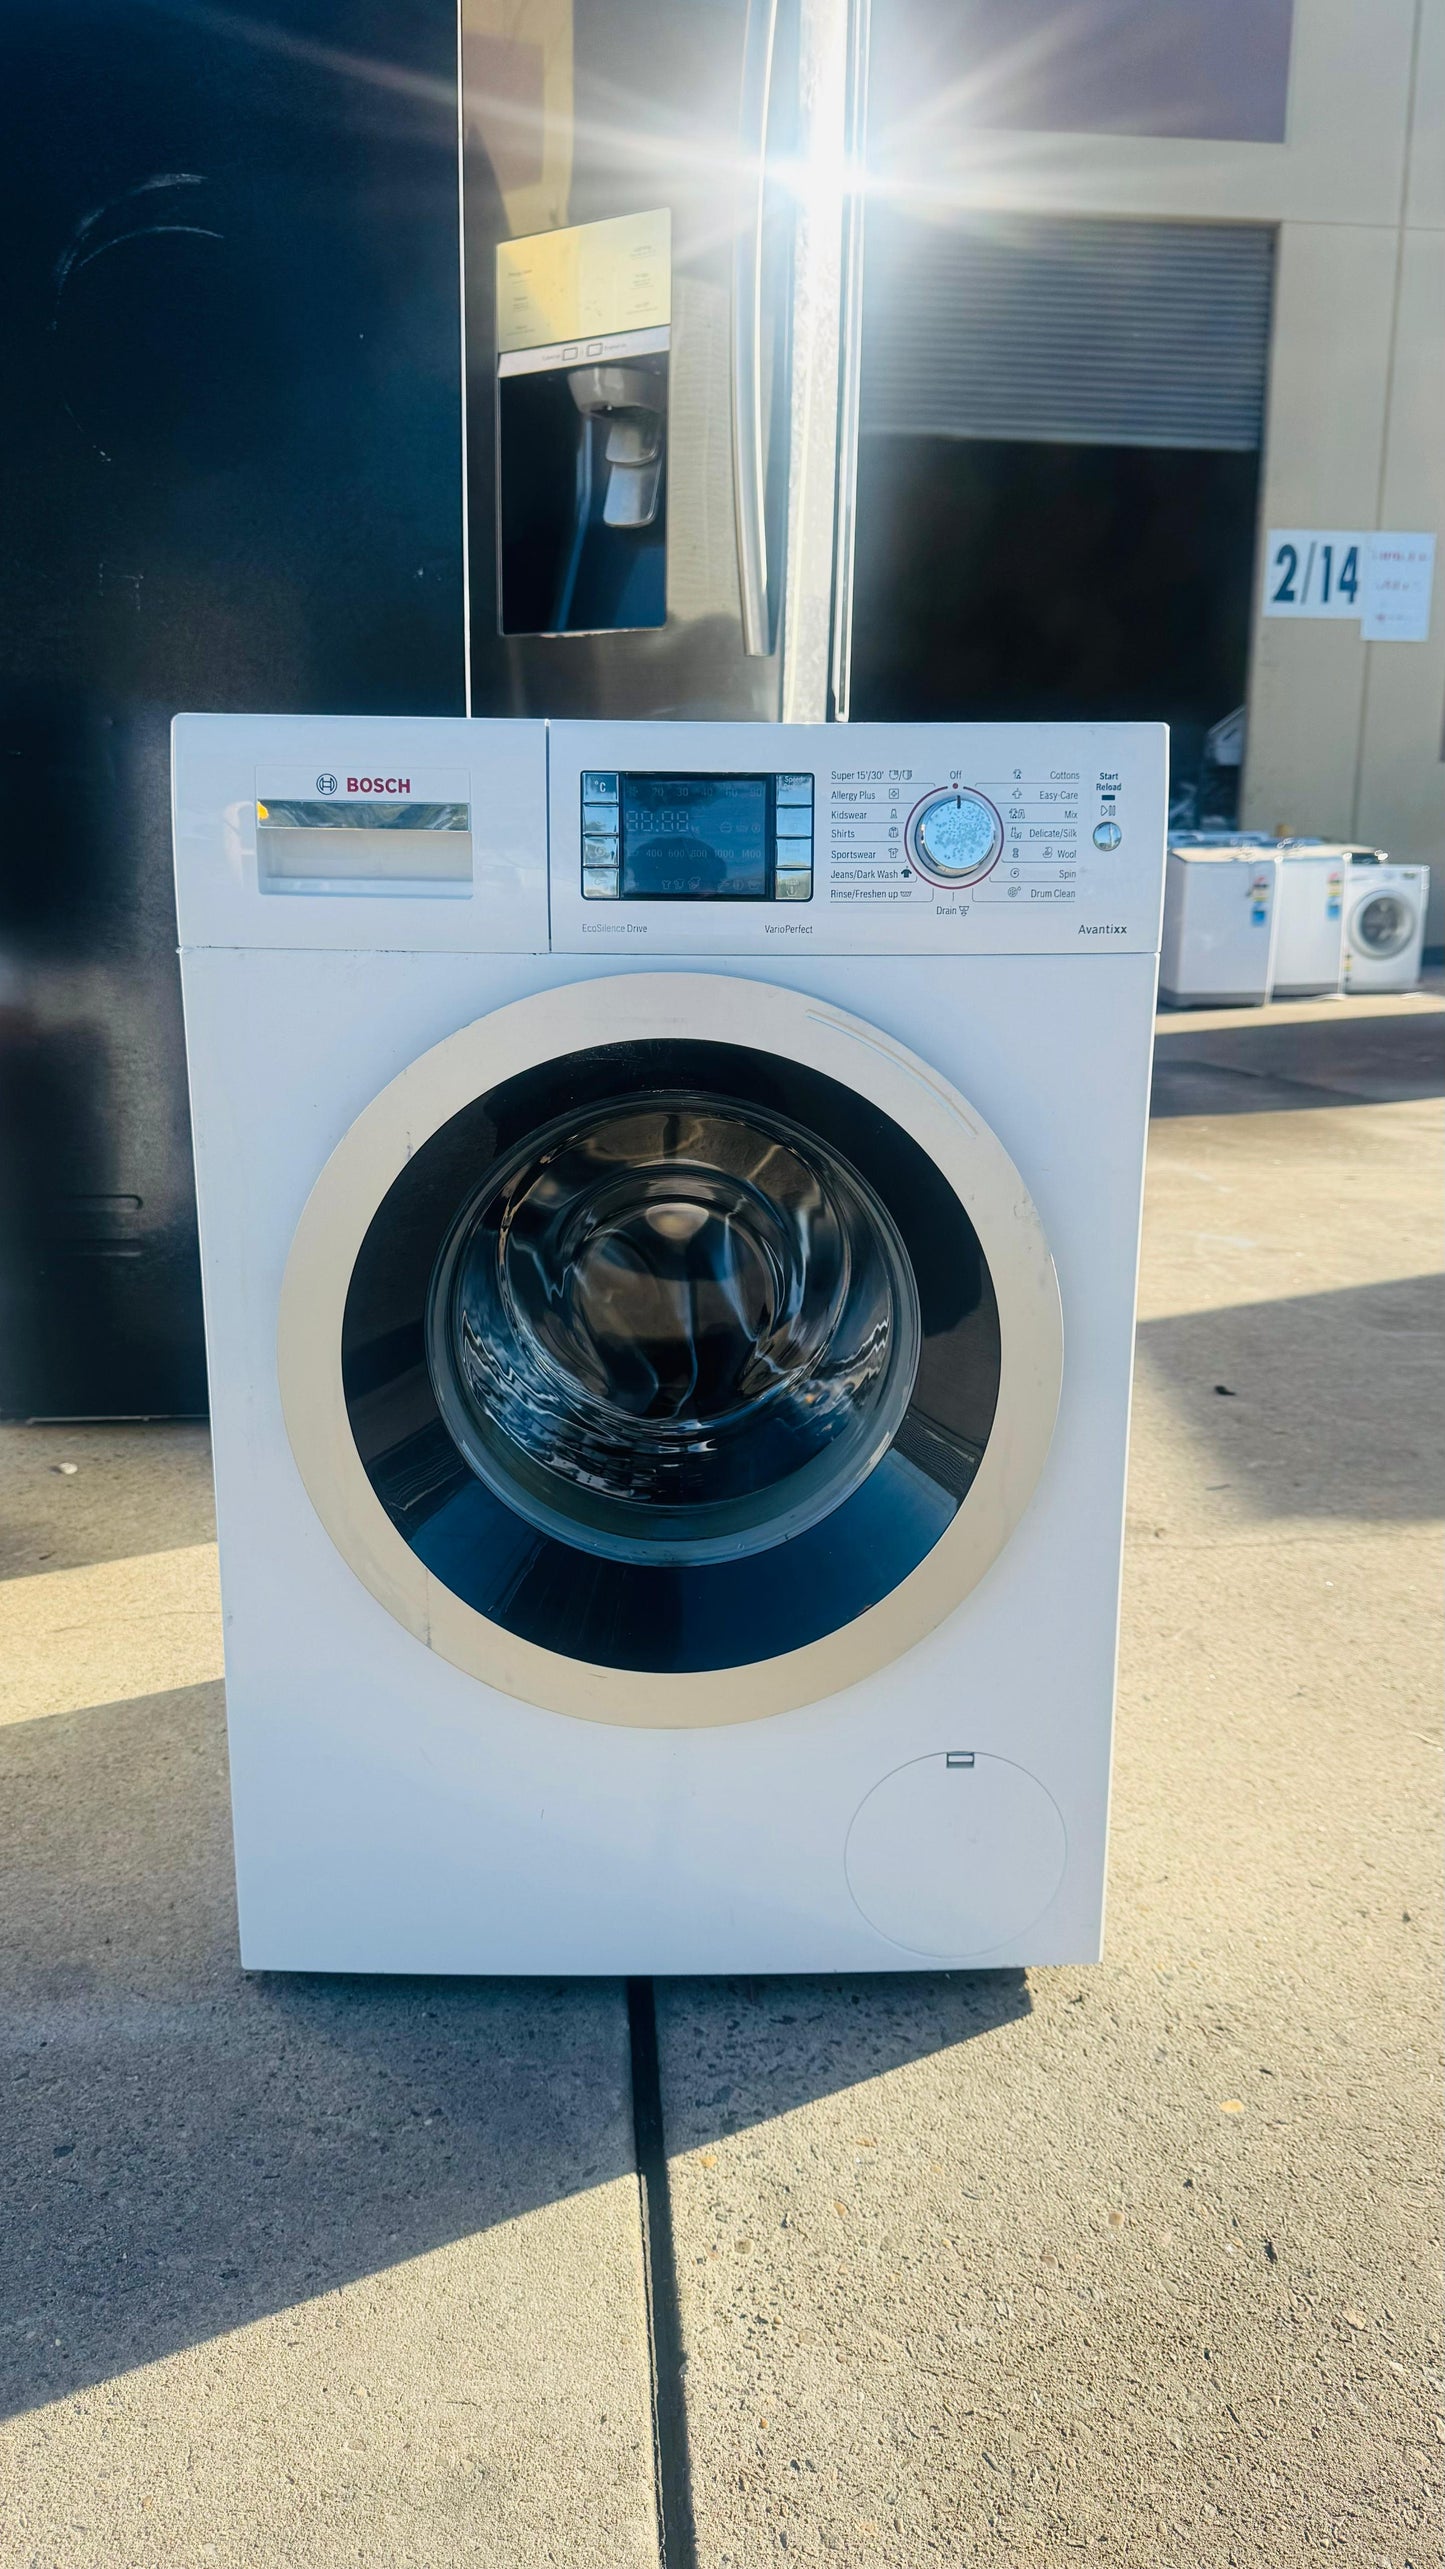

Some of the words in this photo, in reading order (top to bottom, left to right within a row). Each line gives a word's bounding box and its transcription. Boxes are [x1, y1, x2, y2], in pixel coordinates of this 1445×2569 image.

[1273, 541, 1359, 604] 2/14
[831, 771, 854, 782] Super
[950, 770, 962, 780] Off
[1050, 771, 1080, 780] Cottons
[1099, 772, 1119, 781] Start
[347, 777, 411, 793] BOSCH
[1096, 783, 1122, 791] Reload
[831, 791, 857, 801] Allergy
[858, 791, 876, 800] Plus
[831, 810, 867, 819] Kidswear
[1064, 811, 1078, 819] Mix
[831, 829, 855, 838] Shirts
[1029, 829, 1077, 838] Delicate/Silk
[831, 850, 876, 860] Sportswear
[1057, 849, 1077, 859] Wool
[830, 869, 875, 880] Jeans/Dark
[877, 869, 899, 879] Wash
[1059, 869, 1077, 880] Spin
[830, 889, 887, 900] Rinse/Freshen
[888, 891, 899, 900] up
[1030, 889, 1051, 898] Drum
[1053, 889, 1076, 898] Clean
[936, 906, 957, 916] Drain
[582, 924, 625, 934] EcoSilence
[627, 924, 648, 934] Drive
[764, 924, 813, 935] VarioPerfect
[1078, 924, 1128, 935] Avantixx
